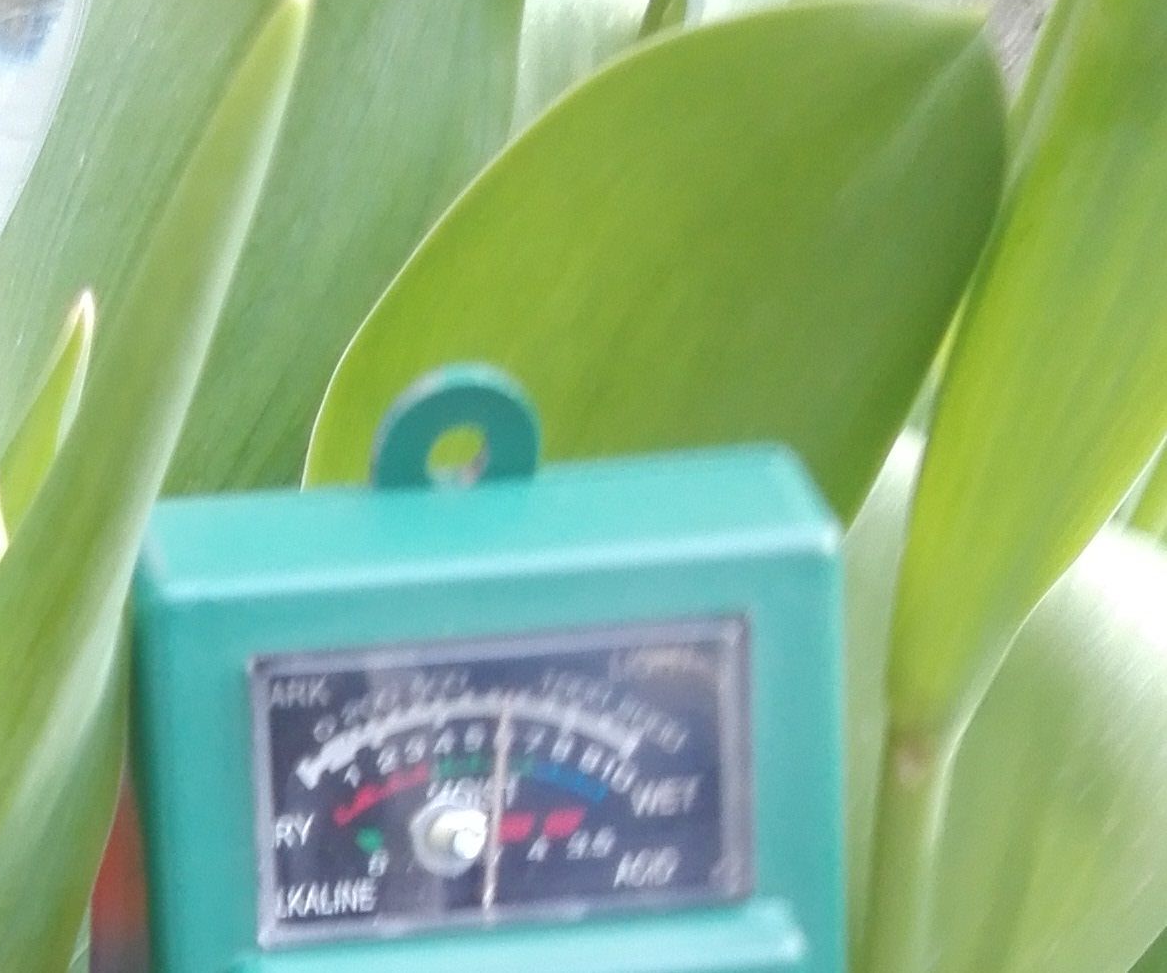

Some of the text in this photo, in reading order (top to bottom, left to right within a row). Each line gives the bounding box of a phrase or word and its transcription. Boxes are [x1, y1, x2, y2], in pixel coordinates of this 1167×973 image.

[270, 675, 331, 708] ARK
[275, 812, 315, 848] RY
[274, 877, 378, 918] LKALINE
